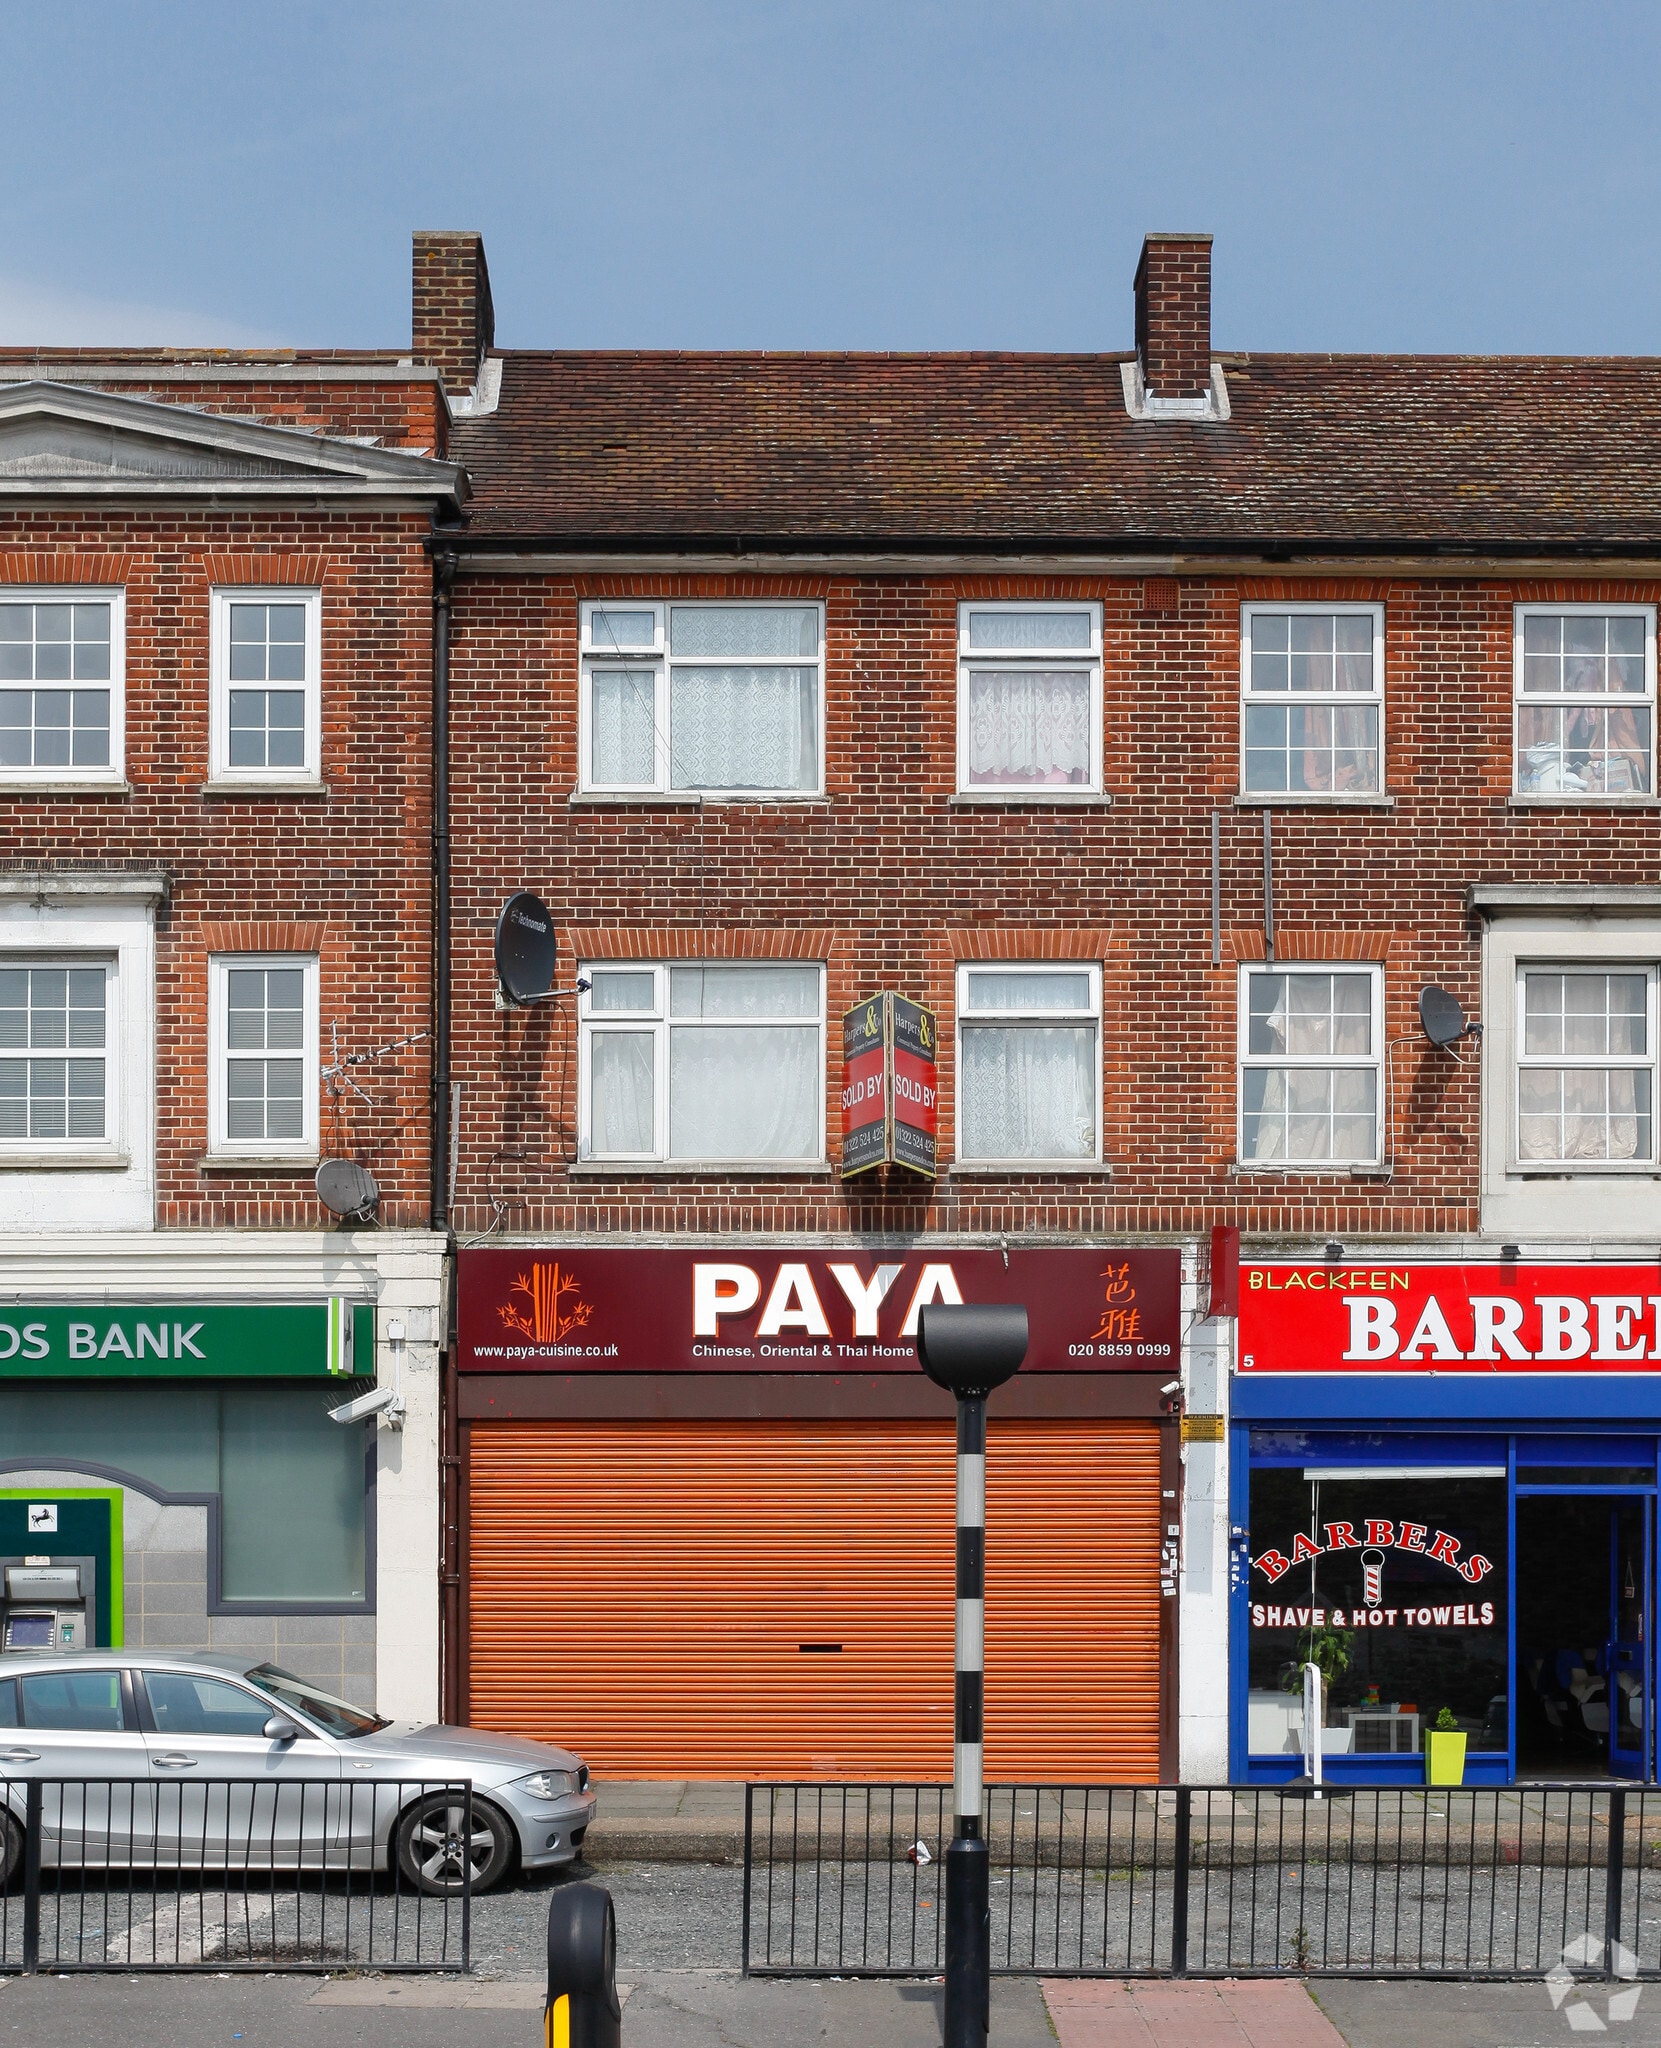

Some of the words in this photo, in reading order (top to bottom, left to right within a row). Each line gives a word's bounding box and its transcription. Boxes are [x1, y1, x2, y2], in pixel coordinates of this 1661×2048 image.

[518, 912, 547, 933] Technomate
[842, 1081, 864, 1110] SOLD
[867, 1073, 883, 1099] BY
[895, 1074, 921, 1103] SOLD
[923, 1086, 936, 1110] BY
[860, 1132, 871, 1147] 524
[872, 1126, 884, 1142] 425
[896, 1126, 912, 1145] 01322
[912, 1135, 924, 1150] 524
[924, 1138, 935, 1154] 425
[1248, 1271, 1410, 1290] BLACKFEN
[692, 1262, 965, 1338] PAYA
[1090, 1262, 1144, 1340] 芭雅
[1341, 1294, 1661, 1361] BARBE
[68, 1323, 207, 1359] BANK
[473, 1343, 619, 1360] www.paya-cuisine.co.uk
[692, 1344, 756, 1359] Chinese,
[760, 1344, 817, 1357] Oriental
[822, 1345, 832, 1357] &
[837, 1344, 868, 1357] Thai
[872, 1344, 914, 1357] Home
[1068, 1344, 1094, 1356] 020
[1098, 1344, 1133, 1356] 8859
[1137, 1344, 1171, 1356] 0999
[1243, 1355, 1255, 1367] 5
[1252, 1519, 1494, 1584] BARBERS
[1252, 1604, 1325, 1627] SHAVE
[1332, 1609, 1346, 1626] &
[1353, 1609, 1398, 1626] HOT
[1404, 1602, 1494, 1627] TOWELS
